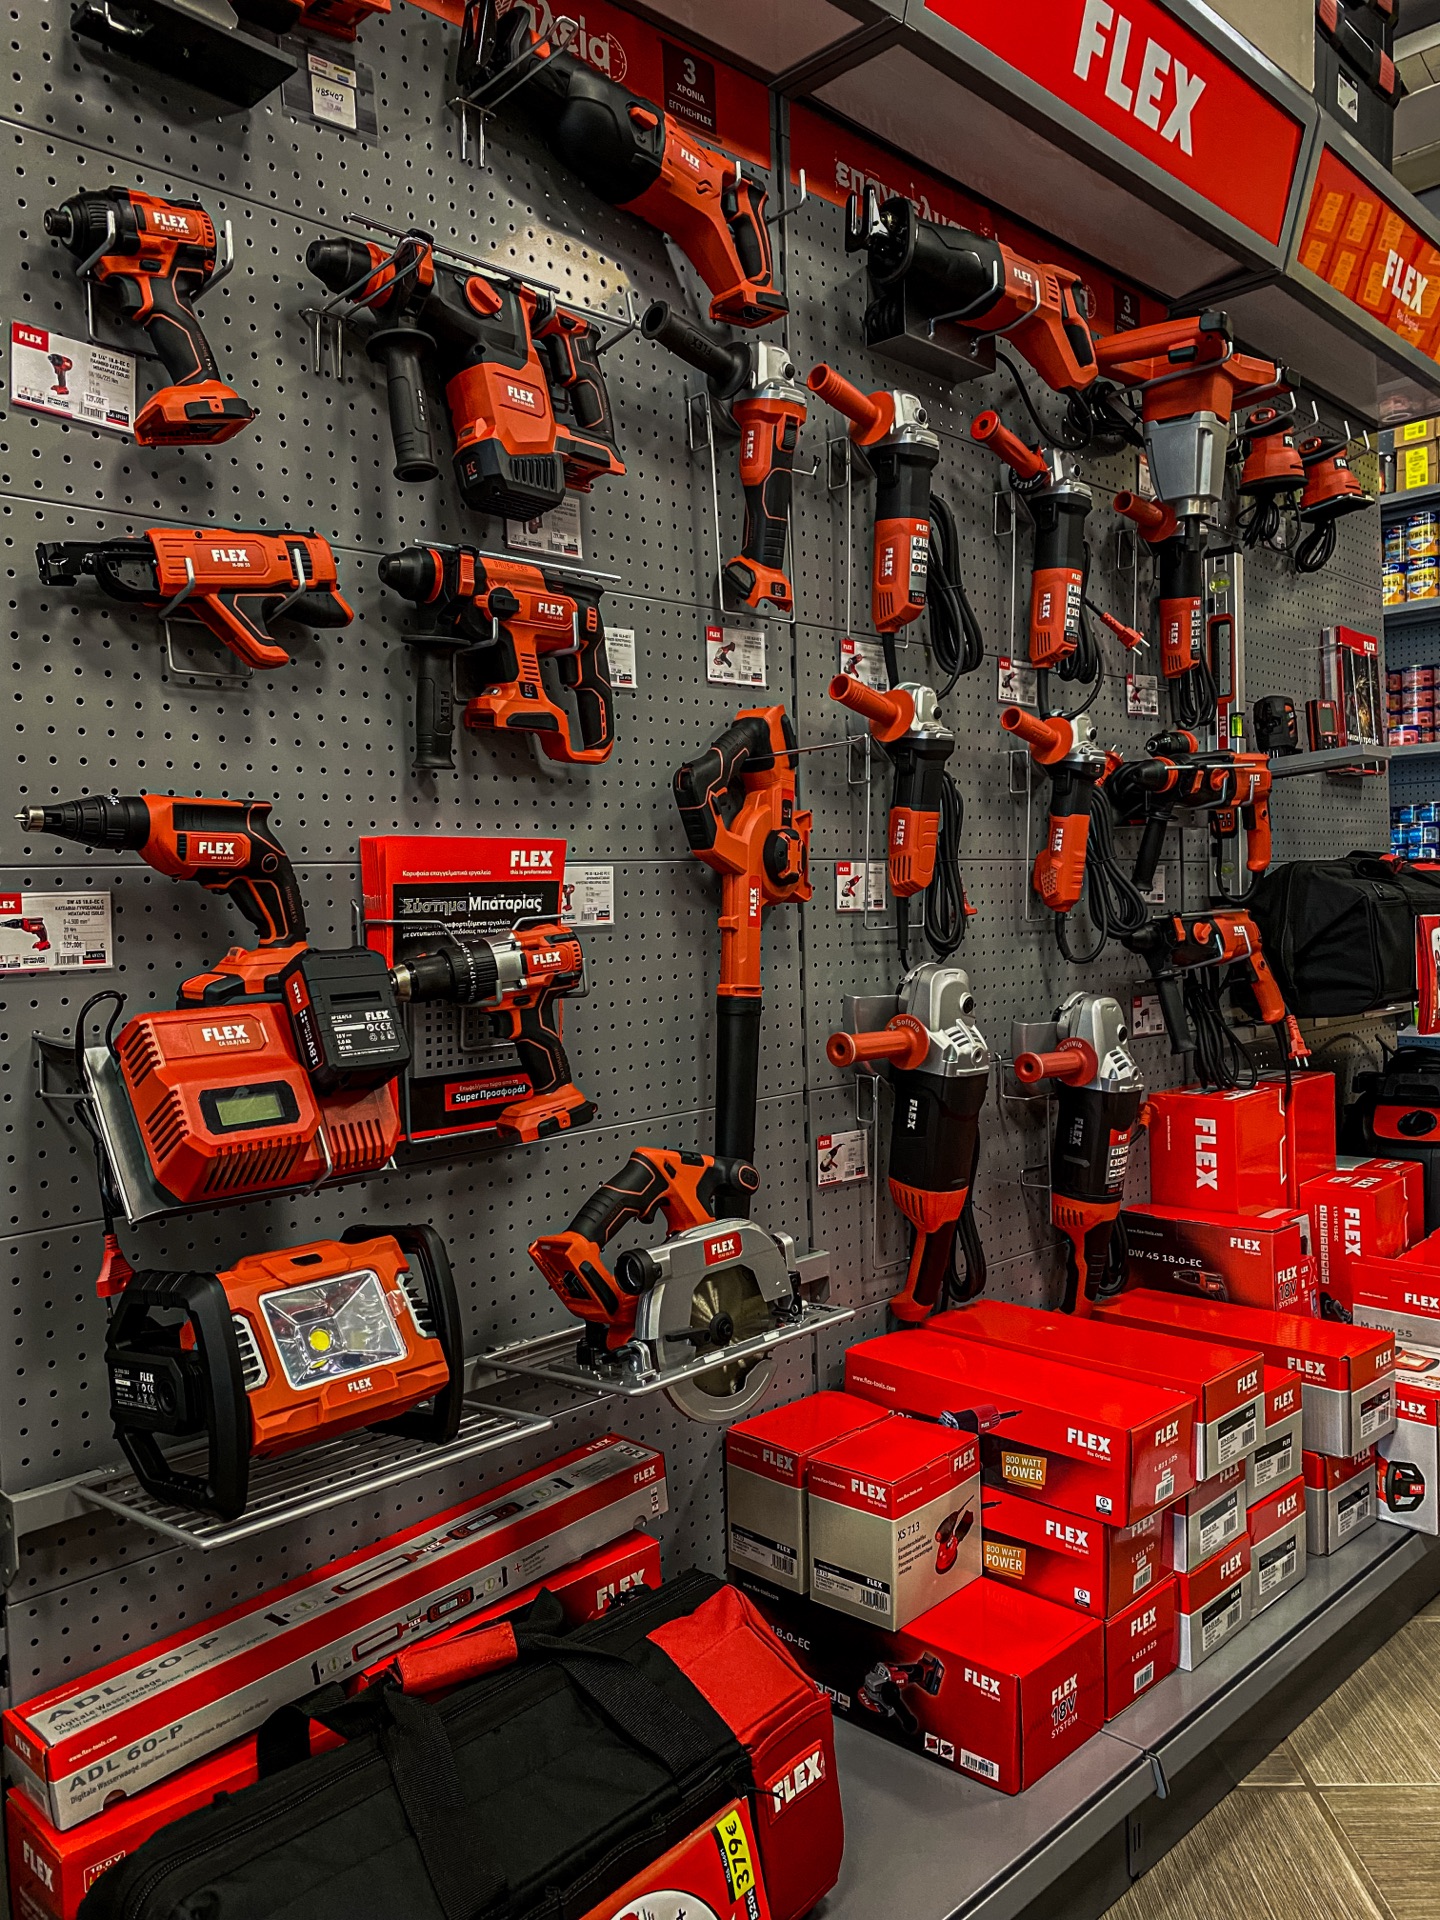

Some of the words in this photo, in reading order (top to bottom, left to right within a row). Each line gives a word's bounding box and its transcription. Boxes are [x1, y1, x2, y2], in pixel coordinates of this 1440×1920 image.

[683, 58, 697, 85] 3
[1073, 0, 1206, 157] FLEX
[676, 82, 706, 104] ΧΡΟΝΙΑ
[680, 147, 701, 170] FLEX
[152, 211, 189, 230] FLEX
[1013, 266, 1033, 284] FLEX
[1382, 248, 1429, 316] FLEX
[1123, 295, 1131, 314] 3
[18, 330, 43, 345] FLEX
[507, 384, 535, 404] FLEX
[747, 429, 755, 459] FLEX
[465, 460, 478, 475] EC
[211, 549, 250, 563] FLEX
[885, 547, 893, 577] FLEX
[538, 602, 564, 616] FLEX
[1043, 592, 1051, 619] FLEX
[1171, 621, 1179, 645] FLEX
[842, 643, 853, 651] FLEX
[1364, 640, 1376, 651] FLEX
[524, 683, 533, 694] EC
[440, 690, 450, 724] FLEX
[1219, 715, 1227, 738] FLEX
[895, 818, 905, 846] FLEX
[1053, 827, 1064, 852] FLEX
[198, 841, 236, 855] FLEX
[509, 850, 554, 867] FLEX
[403, 897, 468, 916] Σύστημα
[749, 887, 758, 917] FLEX
[532, 951, 562, 965] FLEX
[292, 981, 302, 1004] FLEX
[364, 1010, 391, 1020] FLEX
[201, 1024, 249, 1042] FLEX
[896, 1018, 921, 1034] SoftVib
[307, 1041, 319, 1065] 18V
[1059, 1039, 1084, 1053] SoftVib
[456, 1092, 479, 1103] Super
[480, 1084, 526, 1100] Προσφορά!
[907, 1098, 918, 1131] FLEX
[1072, 1117, 1084, 1146] FLEX
[1194, 1117, 1218, 1191] FLEX
[1344, 1207, 1362, 1257] FLEX
[711, 1239, 735, 1256] FLEX
[1229, 1237, 1261, 1252] FLEX
[1128, 1248, 1145, 1259] DW
[1146, 1252, 1160, 1261] 45
[1162, 1254, 1203, 1268] 18.0-EC
[1277, 1265, 1297, 1284] FLEX
[1278, 1279, 1298, 1301] 18V
[1278, 1296, 1299, 1310] SYSTEM
[1404, 1292, 1440, 1309] FLEX
[1397, 1328, 1413, 1338] 55
[1287, 1356, 1326, 1376] FLEX
[1376, 1349, 1392, 1369] FLEX
[140, 1371, 155, 1383] FLEX
[347, 1377, 372, 1393] FLEX
[852, 1374, 896, 1393] www.flex-tools.com
[1237, 1369, 1258, 1394] FLEX
[1273, 1389, 1294, 1412] FLEX
[1395, 1399, 1427, 1416] FLEX
[1067, 1427, 1111, 1455] FLEX
[1155, 1420, 1179, 1447] FLEX
[586, 1438, 612, 1451] FLEX
[762, 1448, 794, 1472] FLEX
[953, 1447, 975, 1472] FLEX
[1005, 1455, 1020, 1465] 800
[1020, 1457, 1042, 1468] WATT
[1087, 1449, 1095, 1457] Das
[1095, 1451, 1111, 1462] Original
[1158, 1460, 1168, 1471] 811
[1168, 1453, 1178, 1465] 125
[633, 1465, 656, 1484] FLEX
[1005, 1465, 1043, 1482] POWER
[851, 1478, 887, 1502] FLEX
[874, 1499, 888, 1509] Original
[1277, 1492, 1297, 1518] FLEX
[897, 1530, 907, 1542] XS
[907, 1521, 920, 1536] 713
[1046, 1519, 1089, 1548] FLEX
[423, 1541, 442, 1552] FLEX
[776, 1543, 791, 1554] FLEX
[986, 1545, 1000, 1554] 800
[1000, 1547, 1022, 1558] WATT
[1065, 1542, 1073, 1550] Das
[1073, 1544, 1090, 1555] Original
[1136, 1550, 1146, 1561] 811
[1146, 1542, 1155, 1554] 125
[985, 1554, 1023, 1572] POWER
[1220, 1551, 1242, 1580] FLEX
[596, 1568, 645, 1611] FLEX
[866, 1578, 883, 1590] FLEX
[408, 1617, 421, 1628] FLEX
[1131, 1607, 1157, 1637] FLEX
[770, 1625, 811, 1650] 18.0-EC
[1136, 1648, 1147, 1660] 811
[1147, 1639, 1157, 1653] 125
[47, 1684, 127, 1724] ADL
[135, 1636, 219, 1682] 60-P
[964, 1668, 1000, 1695] FLEX
[1052, 1673, 1078, 1705] FLEX
[53, 1707, 96, 1732] Digitale
[97, 1677, 163, 1712] Wasserwaage
[1051, 1691, 1078, 1727] 18V
[1051, 1713, 1078, 1739] SYSTEM
[15, 1735, 31, 1759] FLEX
[68, 1735, 117, 1763] www.flex-tools.com
[69, 1759, 121, 1793] ADL
[127, 1724, 184, 1762] 60-P
[70, 1784, 97, 1805] Digitale
[97, 1763, 140, 1792] Wasserwaage
[771, 1750, 823, 1814] FLEX
[90, 1860, 113, 1874] 18.0
[114, 1854, 122, 1863] V
[725, 1819, 750, 1890] 379€
[23, 1840, 54, 1893] FLEX
